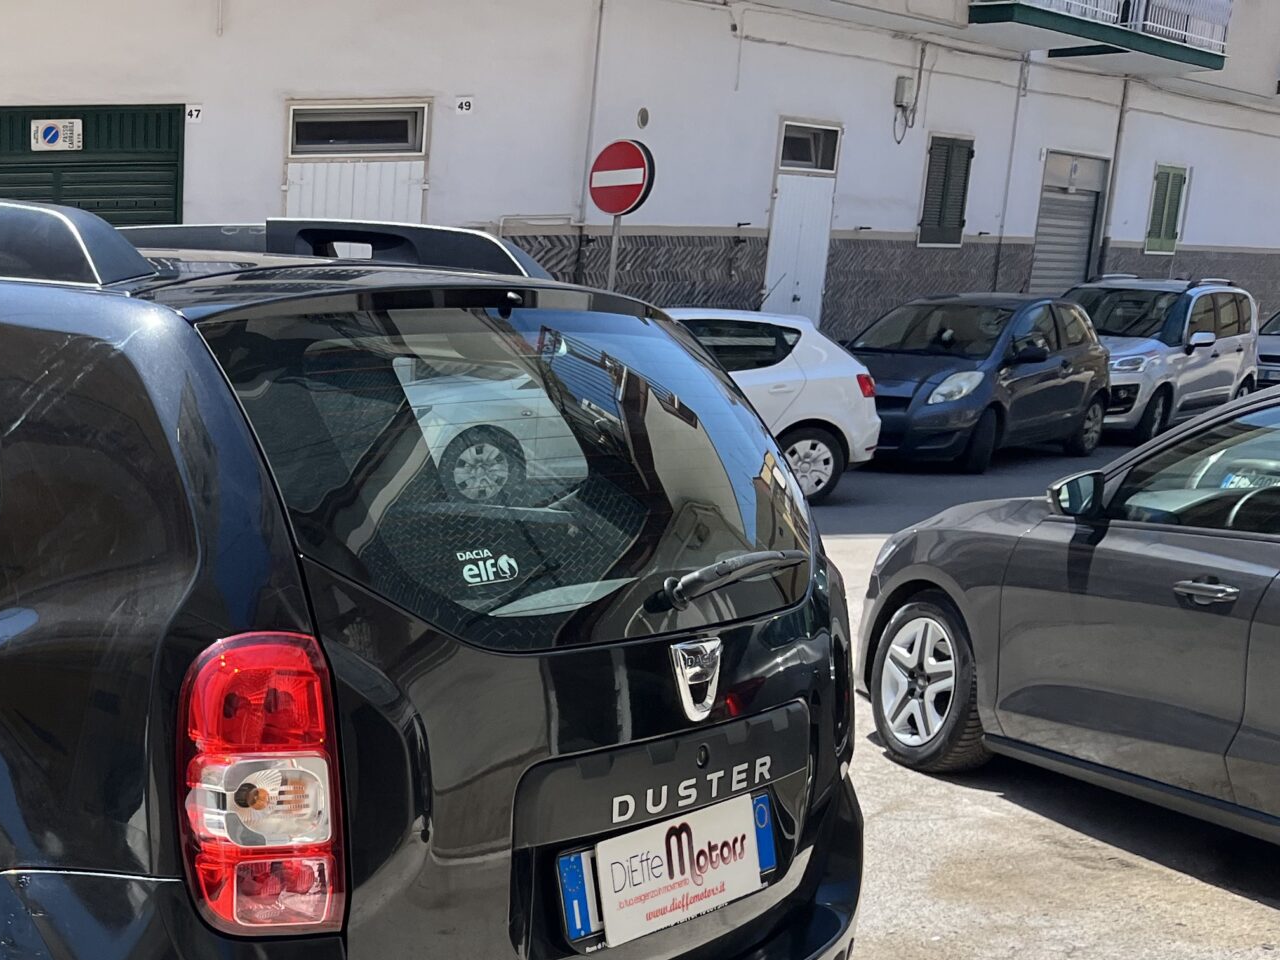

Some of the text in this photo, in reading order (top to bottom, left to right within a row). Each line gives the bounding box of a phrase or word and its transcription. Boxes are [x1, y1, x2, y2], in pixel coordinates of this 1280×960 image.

[187, 109, 201, 119] 47
[457, 101, 472, 111] 49
[456, 549, 493, 561] DACIA
[462, 558, 497, 584] elf
[612, 755, 772, 824] DUSTER
[610, 822, 746, 894] DiEffe Motors
[645, 880, 726, 922] www.dieffemotors.it
